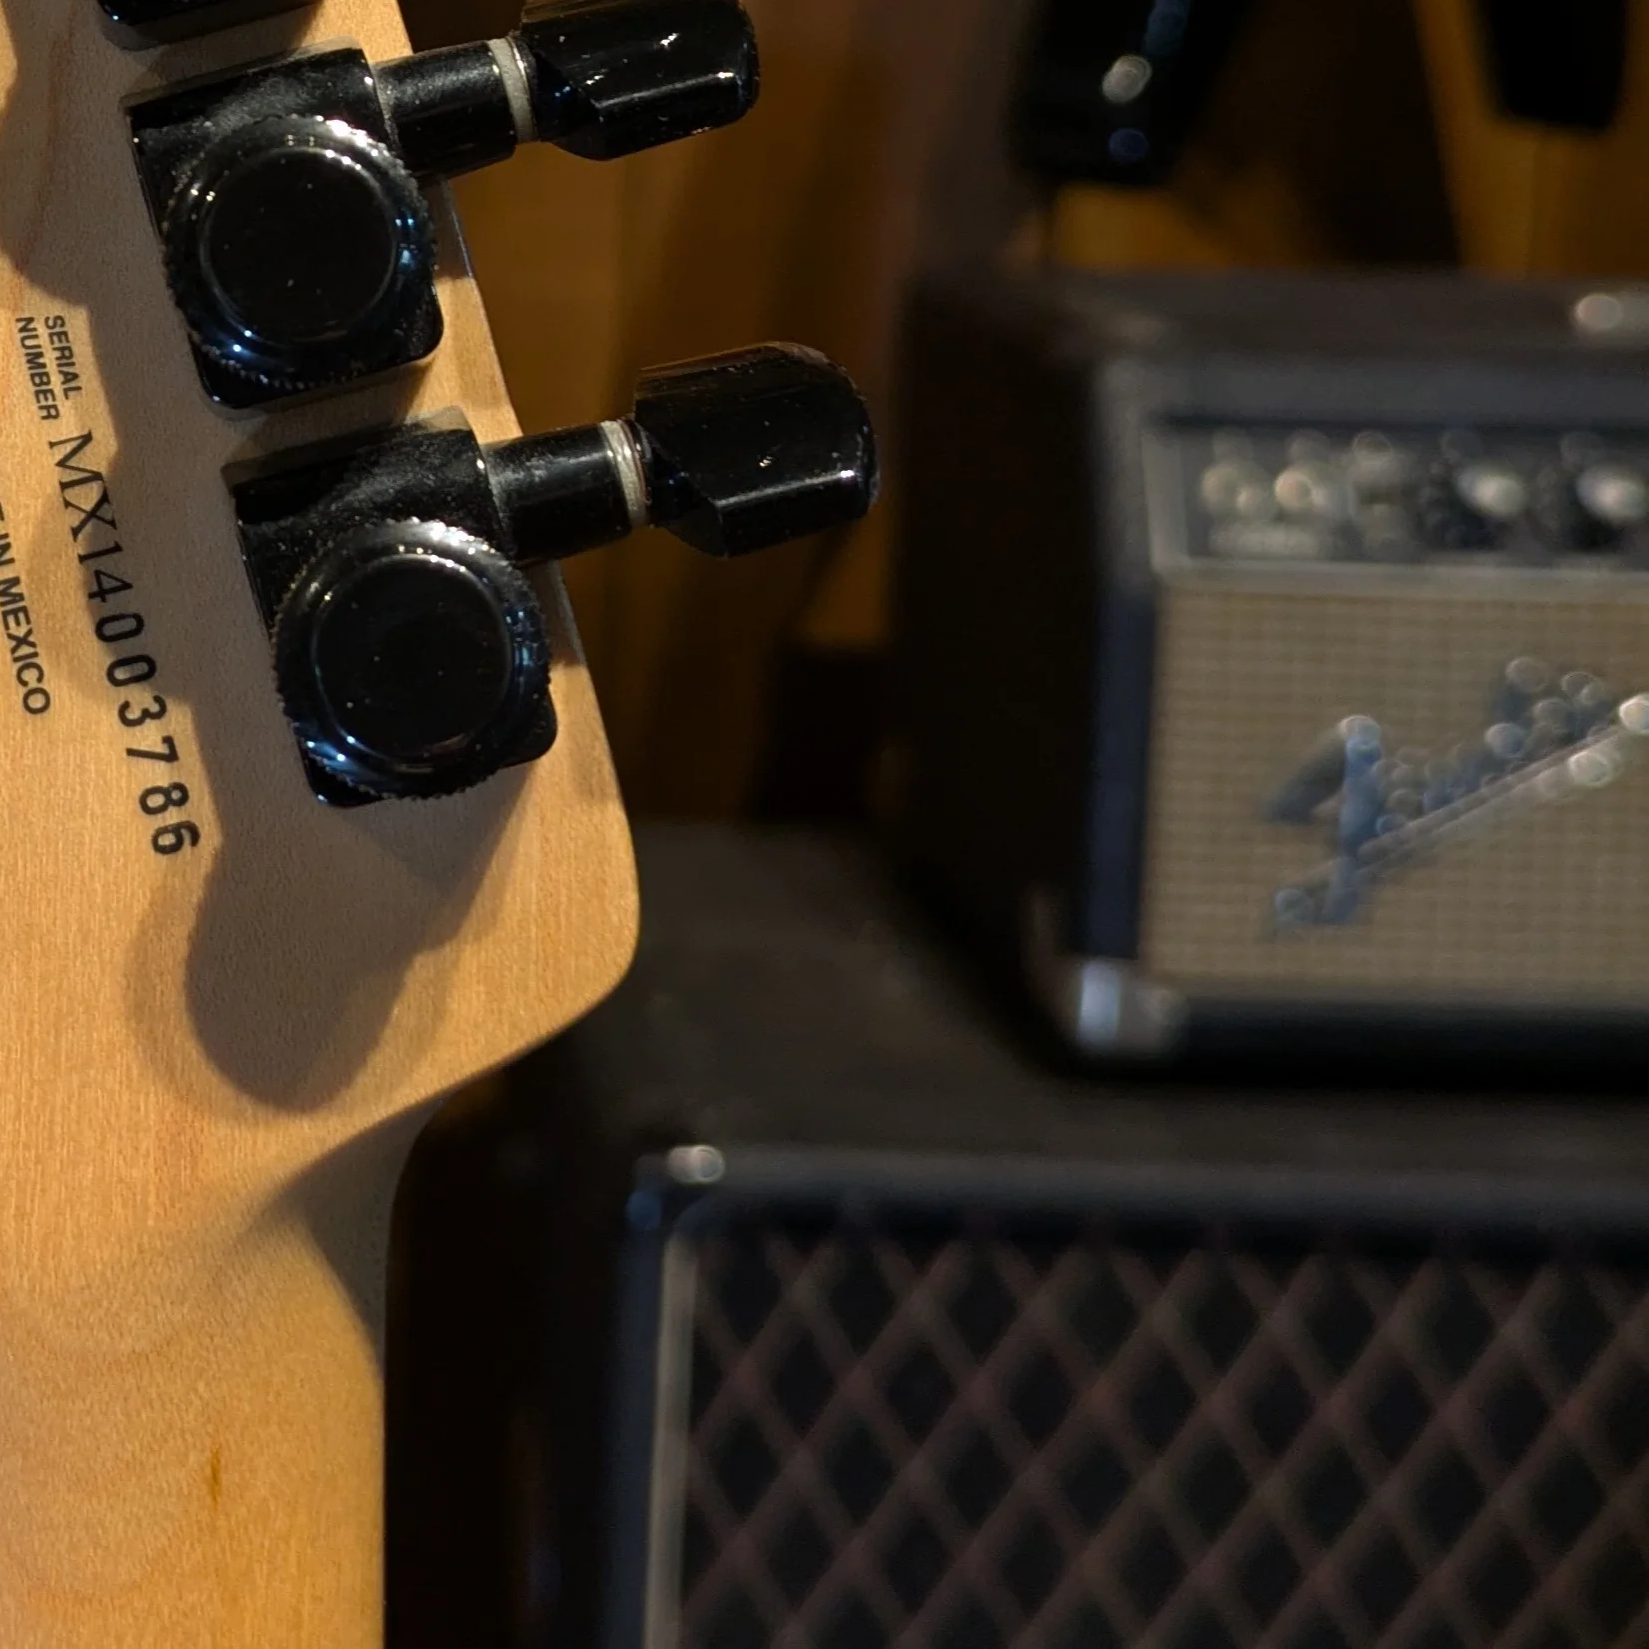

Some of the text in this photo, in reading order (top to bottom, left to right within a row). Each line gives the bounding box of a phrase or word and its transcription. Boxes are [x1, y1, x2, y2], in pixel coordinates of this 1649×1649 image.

[15, 315, 61, 422] NUMBER
[44, 313, 84, 400] SERIAL
[48, 429, 202, 857] MX14003786
